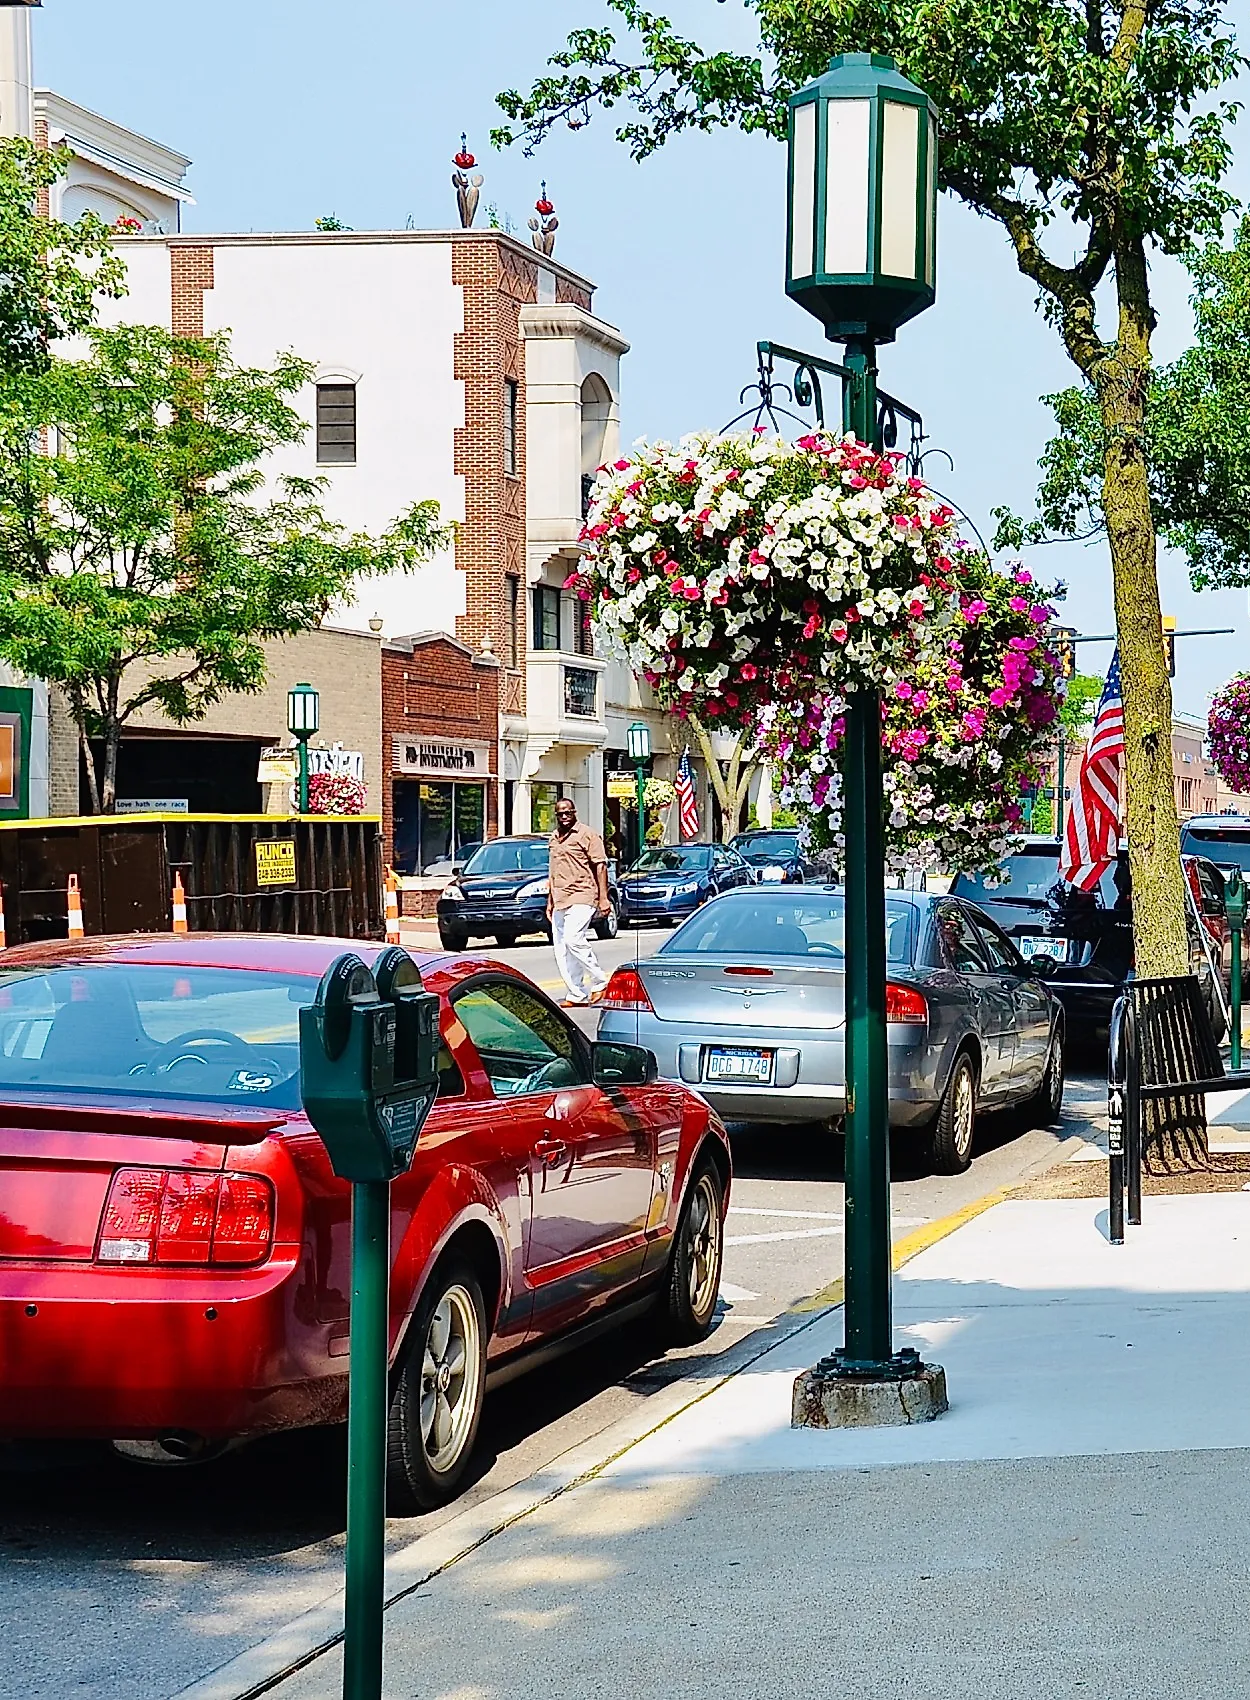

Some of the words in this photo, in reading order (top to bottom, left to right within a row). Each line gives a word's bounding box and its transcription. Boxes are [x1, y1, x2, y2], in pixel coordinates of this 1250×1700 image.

[419, 754, 464, 769] INVESTMENTS
[256, 843, 294, 861] RUNCO
[711, 1057, 732, 1073] BCG
[740, 1058, 768, 1074] 1748
